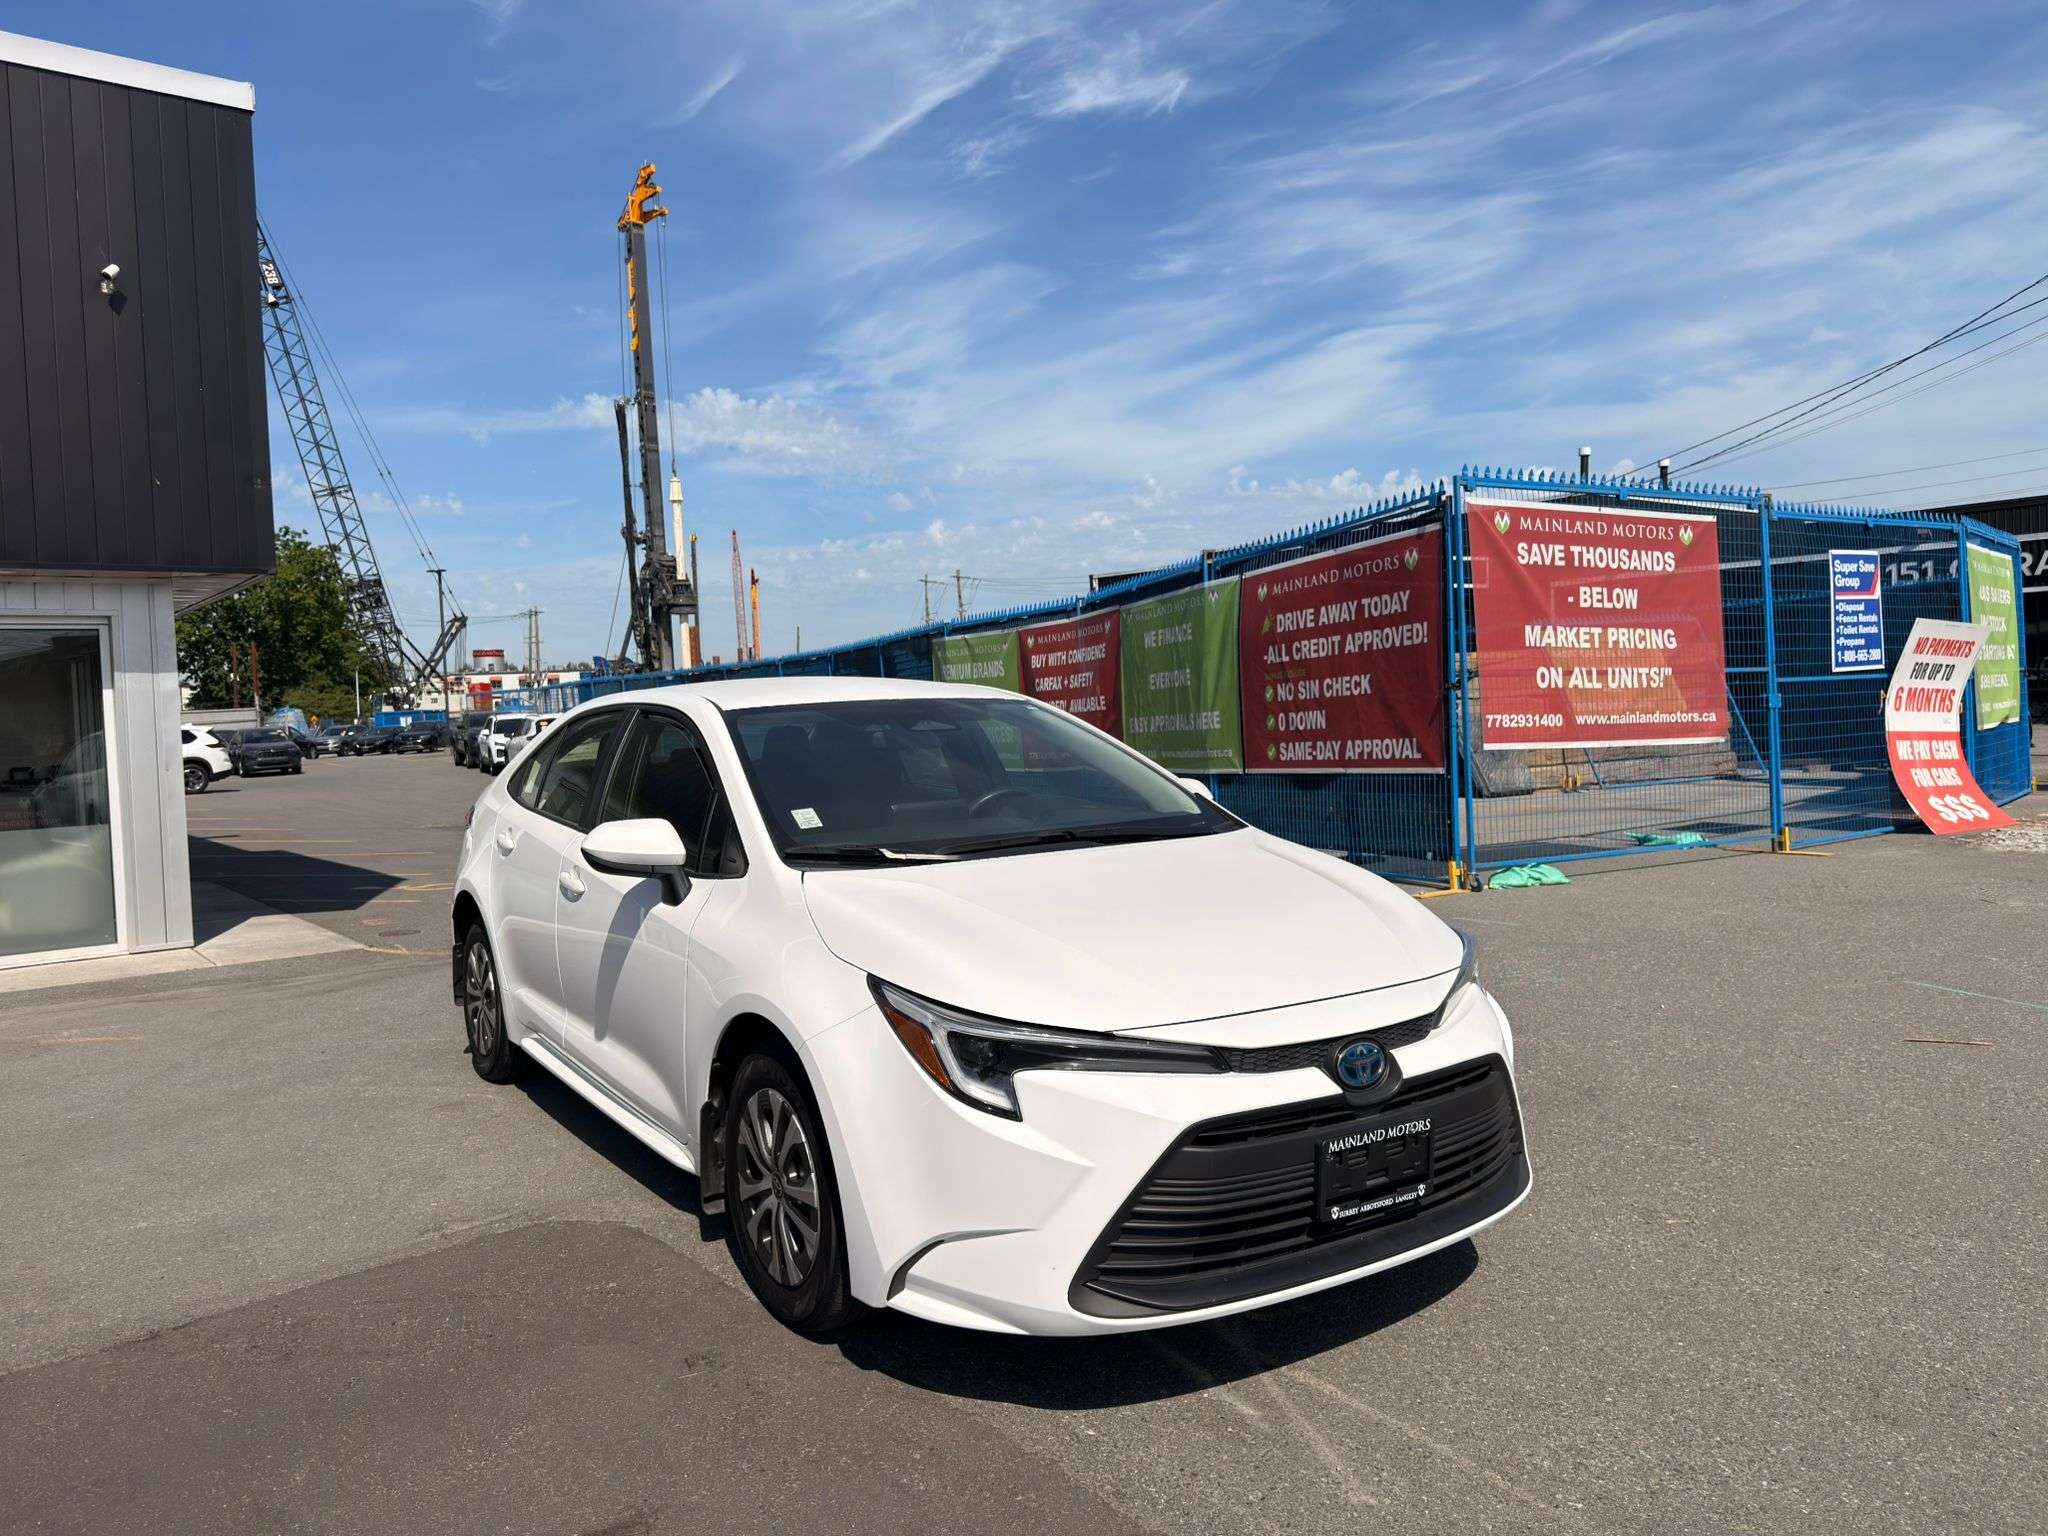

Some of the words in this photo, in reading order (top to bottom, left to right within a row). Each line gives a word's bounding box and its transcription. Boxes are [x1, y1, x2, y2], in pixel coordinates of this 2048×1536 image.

[1519, 516, 1608, 536] MAINLAND
[1612, 523, 1675, 541] MOTORS
[1517, 542, 1566, 567] SAVE
[1569, 545, 1676, 572] THOUSANDS
[1834, 560, 1858, 574] Super
[1859, 560, 1875, 573] Save
[1272, 569, 1340, 595] MAINLAND
[1343, 555, 1400, 580] MOTORS
[1835, 575, 1860, 589] Group
[1579, 586, 1638, 609] BELOW
[1276, 608, 1315, 633] DRIVE
[1318, 600, 1358, 626] AWAY
[1361, 590, 1410, 619] TODAY
[1038, 630, 1076, 645] MAINLAND
[1078, 623, 1103, 637] MOTORS
[1144, 630, 1156, 649] WE
[1292, 635, 1341, 661] CREDIT
[1344, 621, 1428, 654] APPROVED!
[1525, 625, 1601, 648] MARKET
[1607, 627, 1677, 649] PRICING
[1031, 654, 1047, 668] BUY
[1048, 651, 1067, 667] WITH
[1068, 643, 1106, 664] CONFIDENCE
[1914, 636, 1930, 655] NO
[1926, 638, 1976, 658] PAYMENTS
[973, 660, 1005, 679] BRANDS
[1150, 668, 1191, 690] EVERYONE
[1536, 667, 1563, 689] ON
[1568, 667, 1603, 689] ALL
[1607, 667, 1673, 689] UNITS!"
[1910, 661, 1930, 680] FOR
[1928, 662, 1943, 680] UP
[1941, 664, 1955, 681] TO
[1035, 675, 1062, 692] CARFAX
[1069, 672, 1093, 689] SAFETY
[1277, 682, 1294, 701] NO
[1298, 680, 1319, 700] SIN
[1323, 674, 1372, 697] CHECK
[1069, 695, 1106, 713] AVAILABLE
[1894, 686, 1904, 712] 6
[1905, 687, 1956, 713] MONTHS
[1150, 713, 1195, 732] APPROVALS
[1196, 711, 1221, 730] HERE
[1278, 712, 1286, 731] 0
[1289, 710, 1326, 730] DOWN
[1486, 714, 1563, 728] 7782931400
[1575, 711, 1717, 726] www.mainlandmotors.ca
[1279, 740, 1341, 761] SAME-DAY
[1345, 738, 1422, 760] APPROVAL
[1896, 740, 1914, 760] WE
[1912, 740, 1931, 760] PAY
[1931, 740, 1960, 760] CASH
[1910, 767, 1936, 788] FOR
[1931, 767, 1963, 787] CARS
[1927, 793, 1990, 824] $$$
[1328, 1129, 1386, 1154] MAINLAND
[1387, 1118, 1431, 1138] MOTORS
